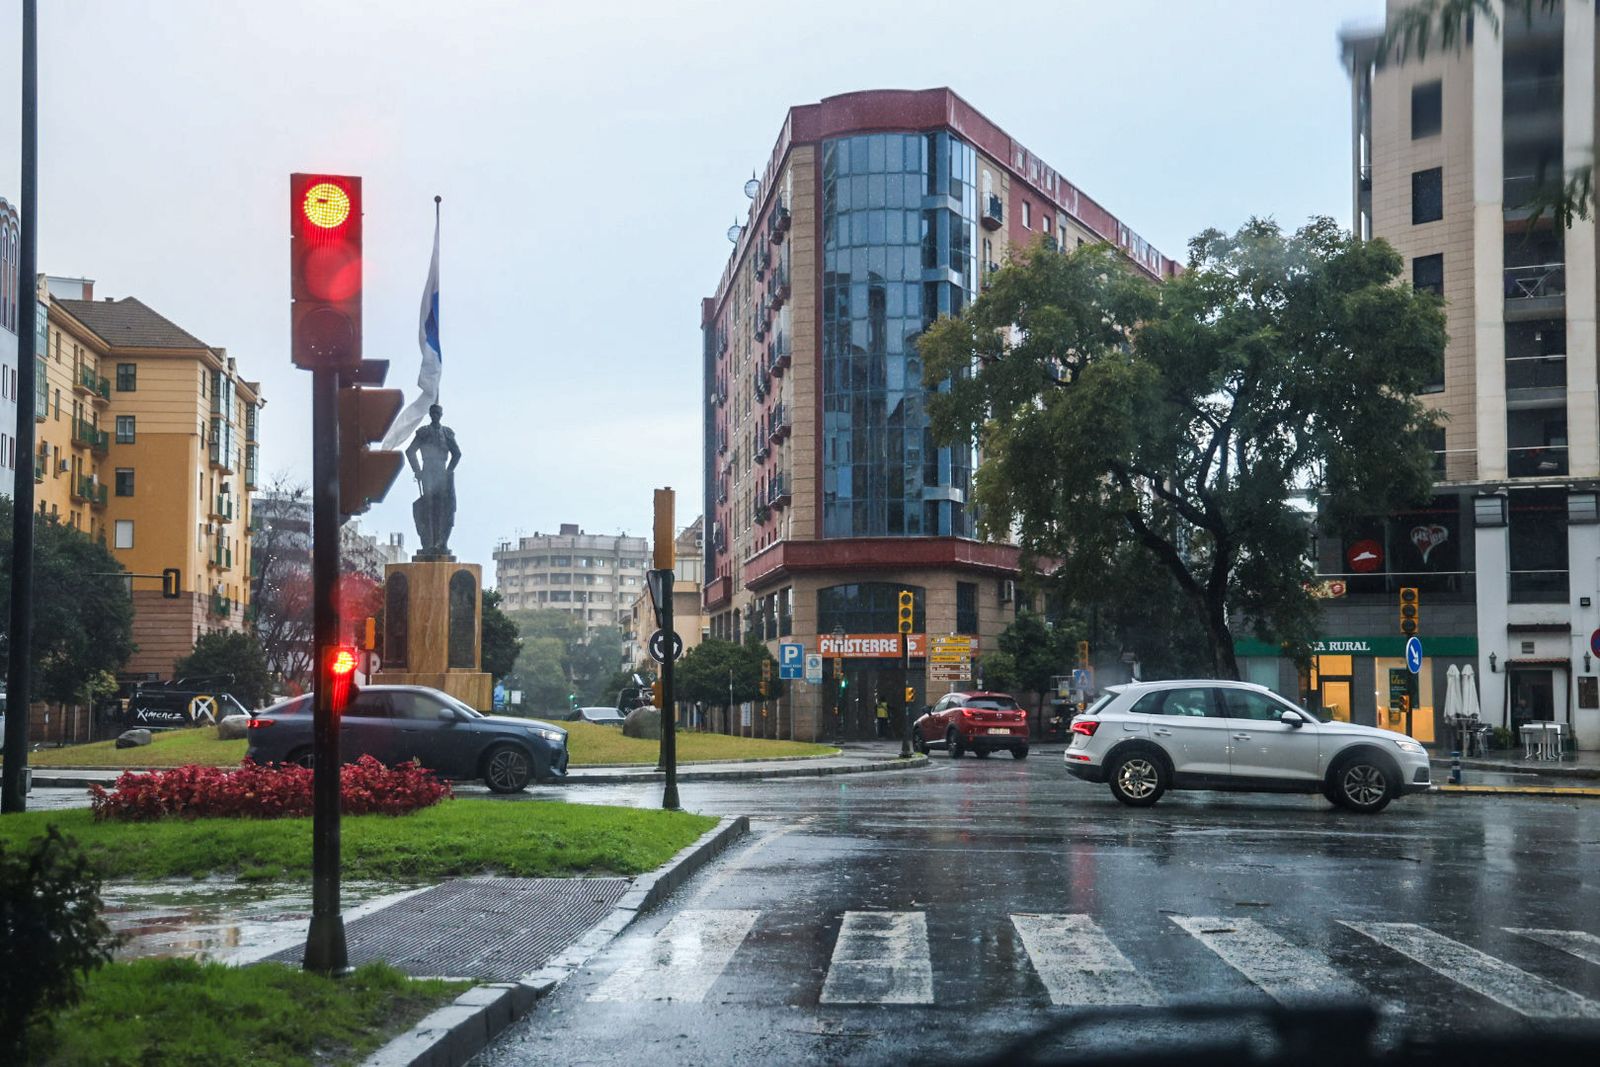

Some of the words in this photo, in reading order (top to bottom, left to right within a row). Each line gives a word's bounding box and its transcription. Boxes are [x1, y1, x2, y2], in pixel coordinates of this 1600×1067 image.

[1328, 641, 1371, 651] RURAL
[784, 645, 799, 664] P
[136, 707, 184, 722] Ximenez
